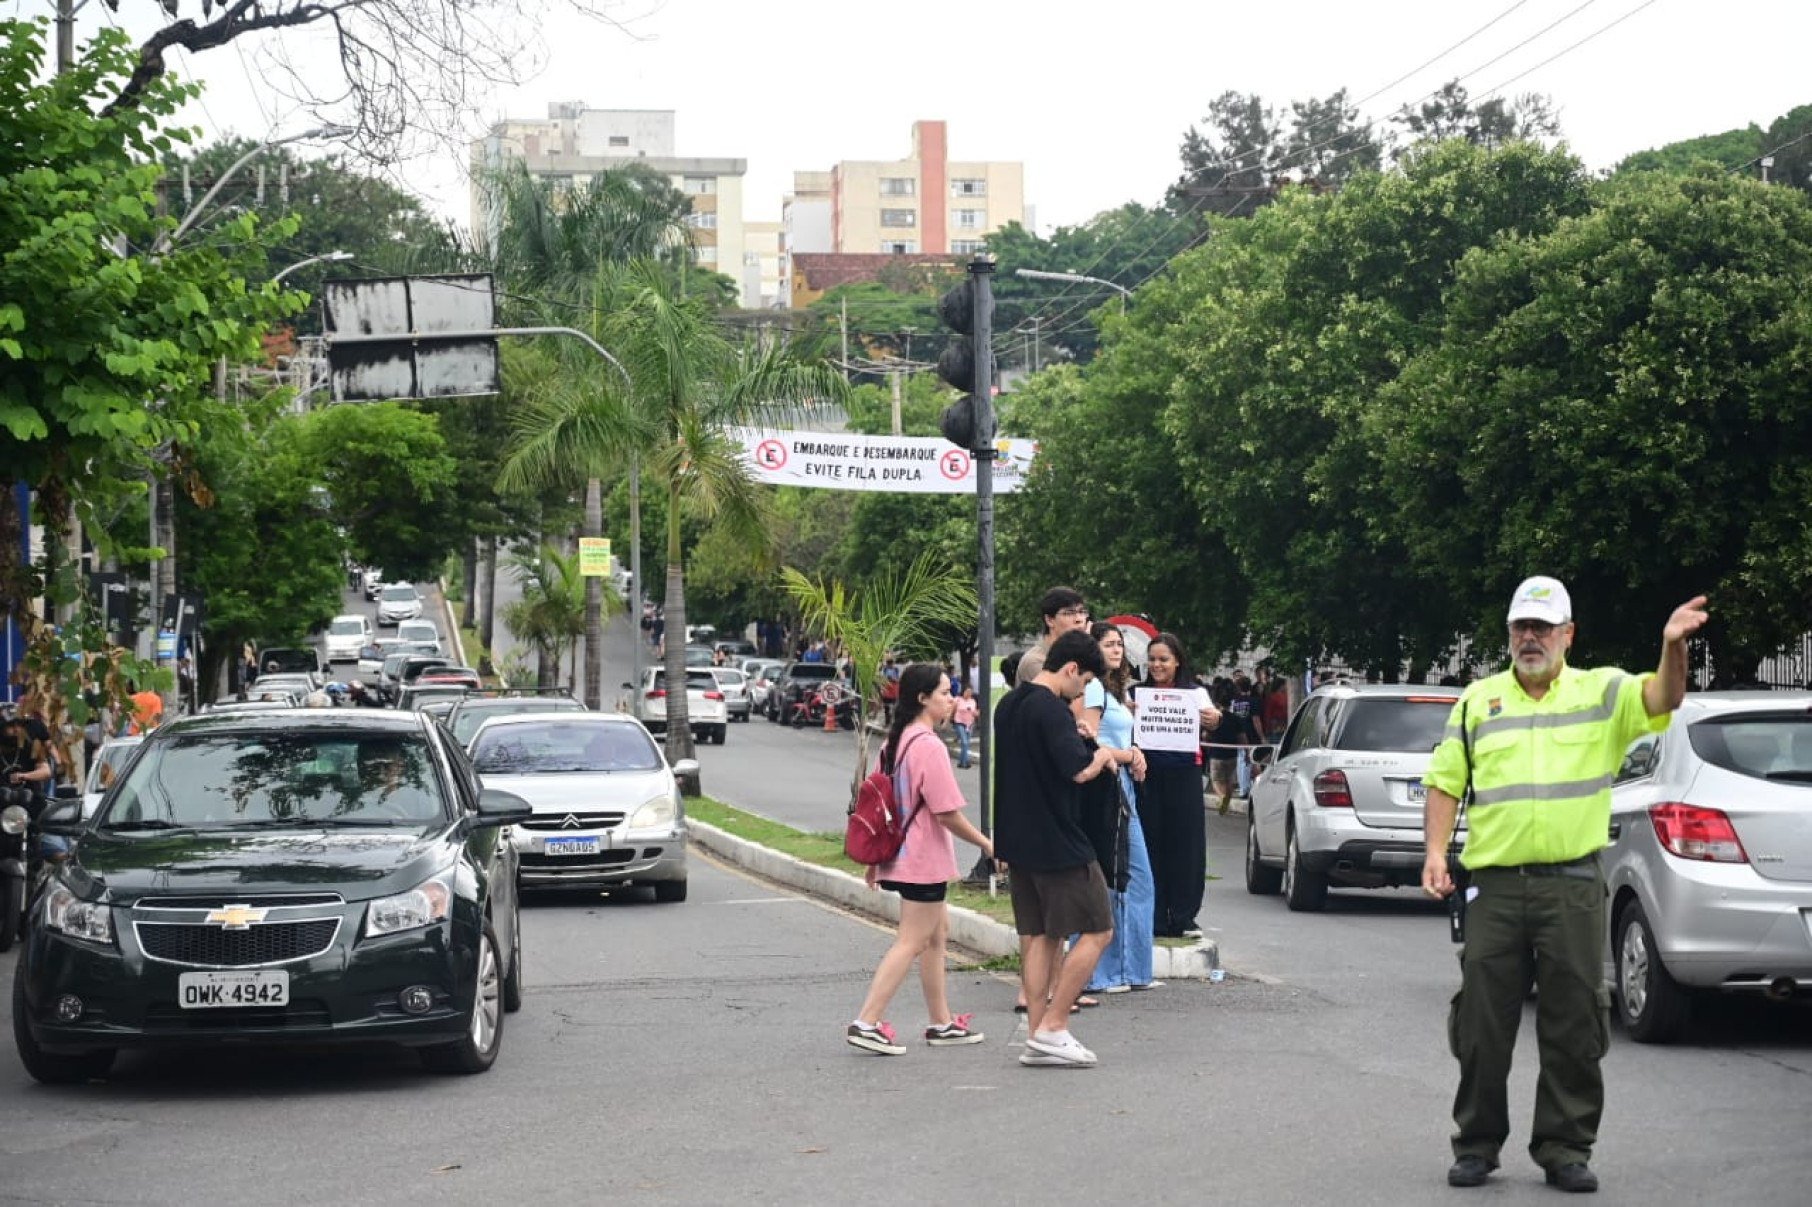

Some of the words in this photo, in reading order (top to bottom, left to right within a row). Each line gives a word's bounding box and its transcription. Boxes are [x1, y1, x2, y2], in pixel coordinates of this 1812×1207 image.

[793, 441, 850, 457] EMBARQUE
[854, 446, 861, 457] E
[863, 446, 937, 461] DESEMBARQUE
[806, 463, 842, 477] EVITE
[847, 466, 876, 479] FILA
[883, 467, 922, 481] DUPLA
[1169, 707, 1187, 715] VALE
